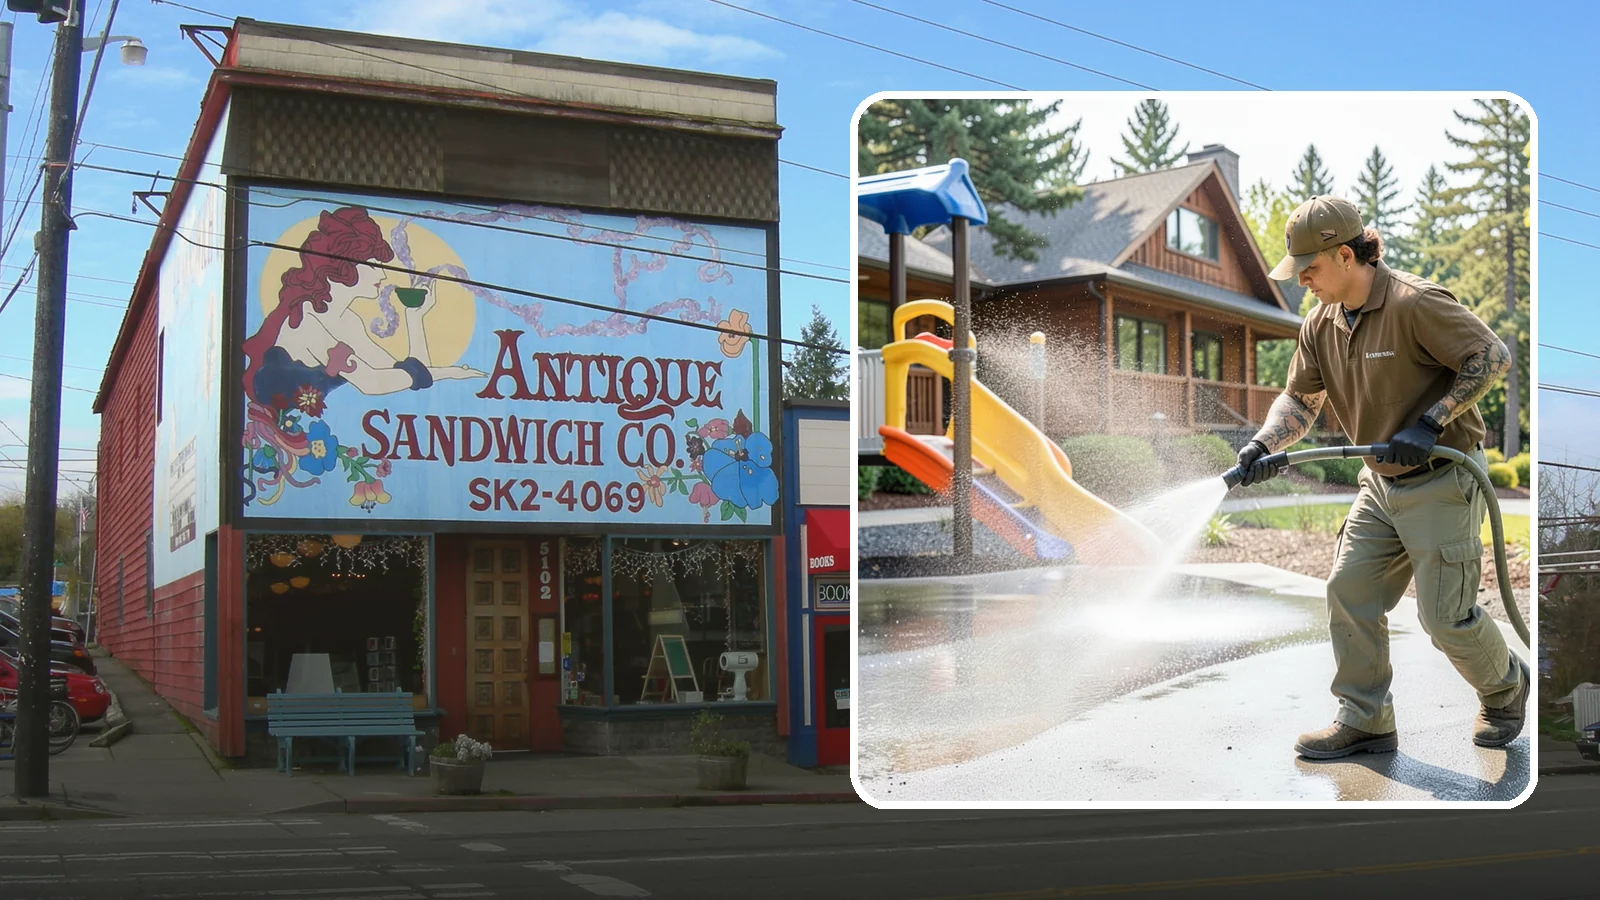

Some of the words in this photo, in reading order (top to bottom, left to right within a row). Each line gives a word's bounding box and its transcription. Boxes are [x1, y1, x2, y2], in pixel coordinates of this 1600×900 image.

[361, 408, 605, 467] SANDWICH
[617, 421, 685, 469] CO.
[468, 476, 646, 513] SK2-4069
[539, 541, 552, 600] 5102
[809, 555, 835, 569] BOOKS
